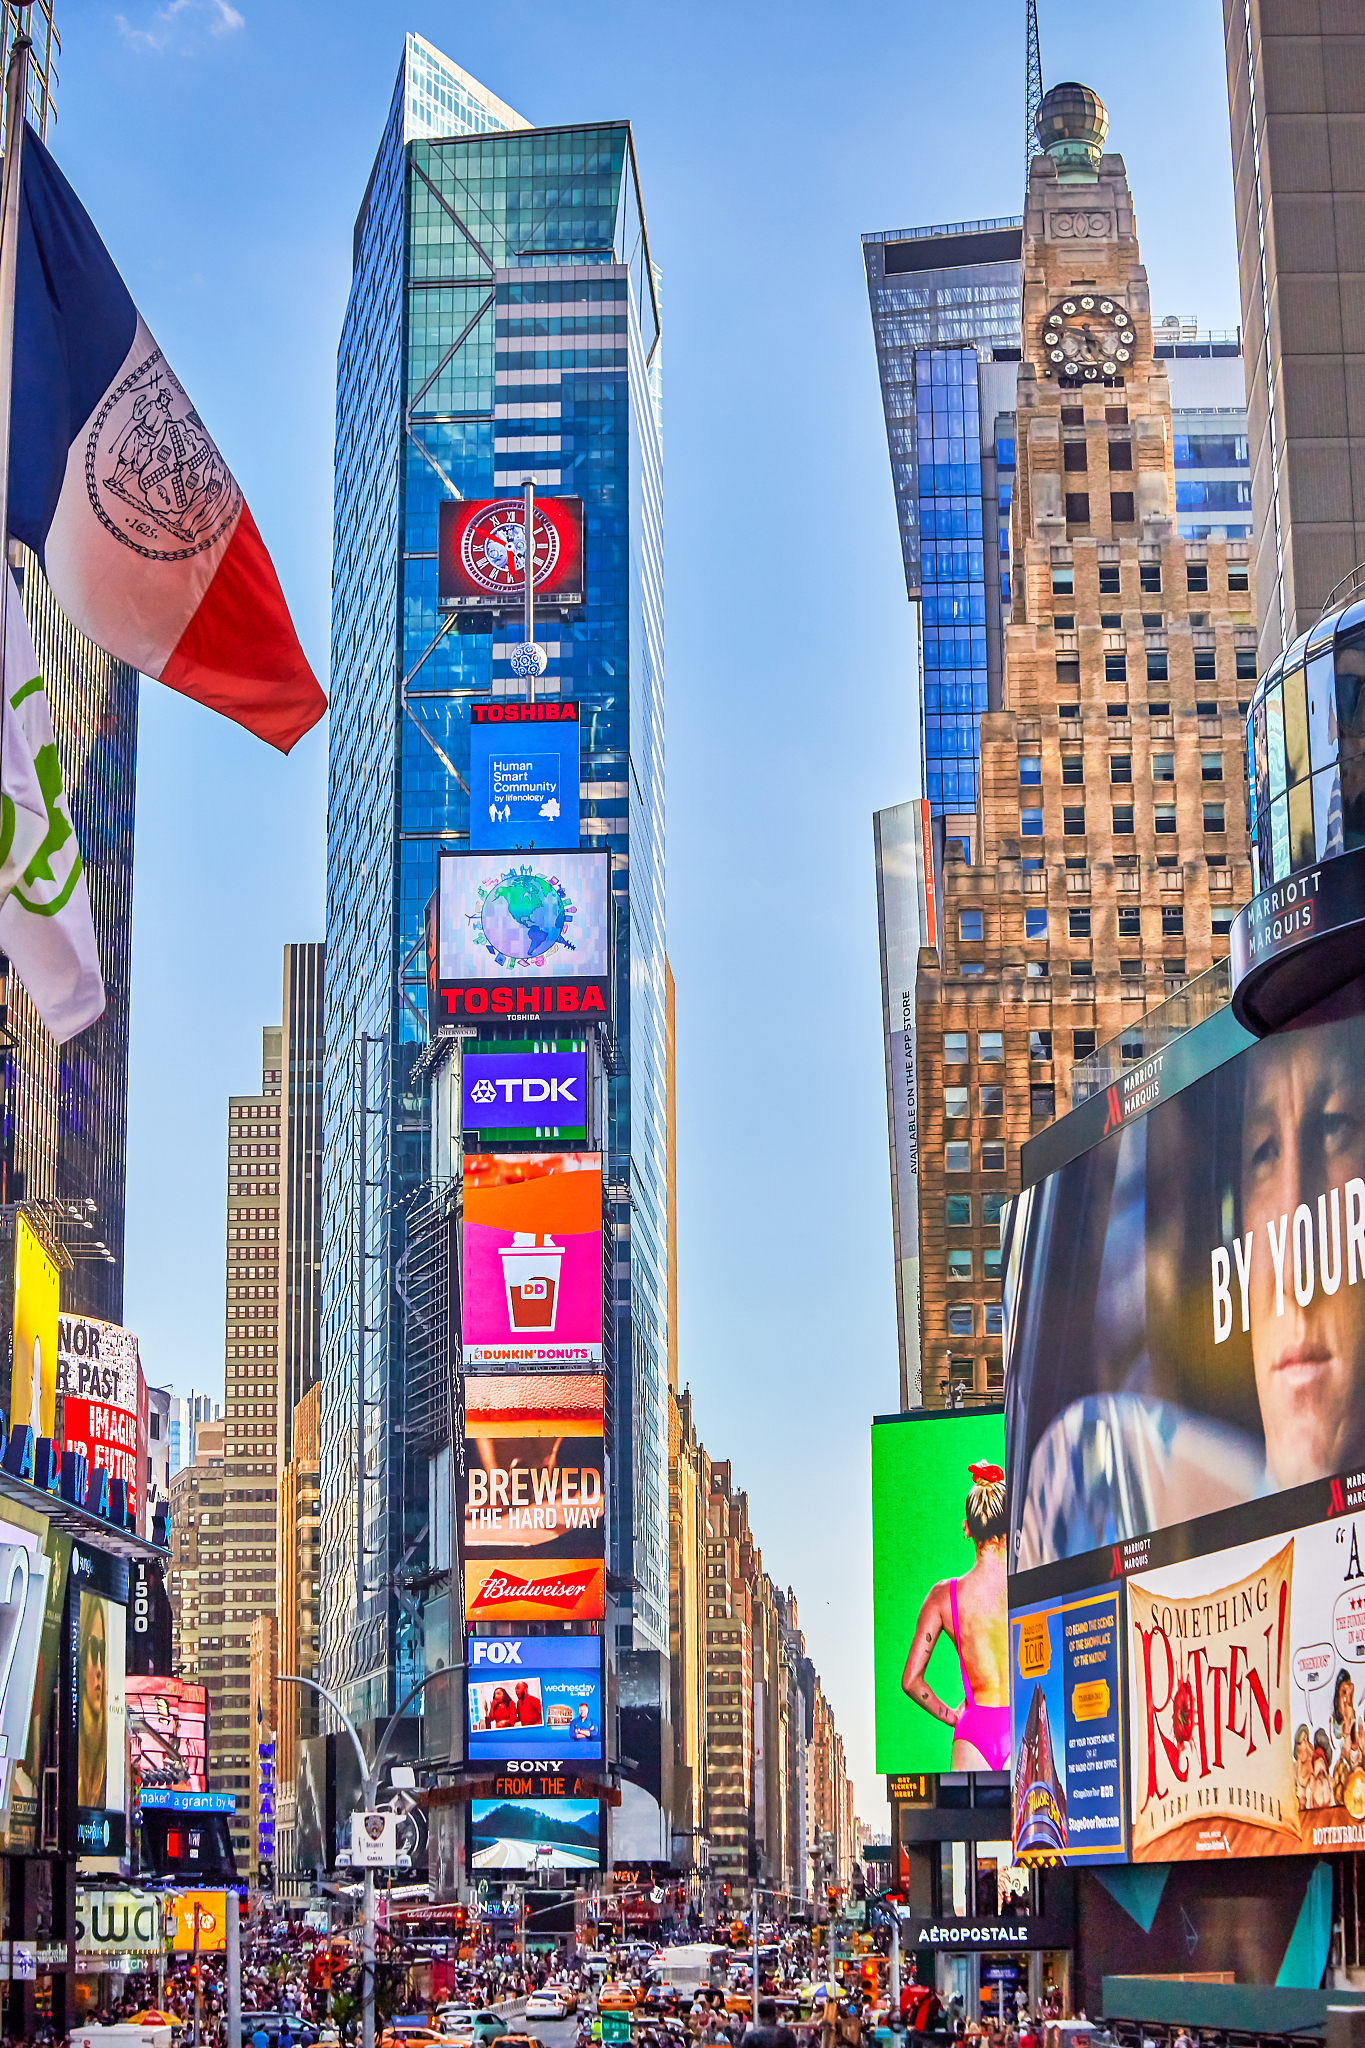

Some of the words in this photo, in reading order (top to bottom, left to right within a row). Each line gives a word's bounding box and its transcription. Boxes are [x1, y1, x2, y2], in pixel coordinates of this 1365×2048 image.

[472, 704, 577, 722] TOSHIBA
[493, 761, 533, 772] Human
[493, 772, 528, 782] Smart
[493, 782, 557, 794] Community
[494, 794, 504, 803] by
[505, 793, 545, 803] lifenology
[1248, 871, 1321, 929] MARRIOTT
[1249, 906, 1312, 958] MARQUIS
[441, 986, 606, 1014] TOSHIBA
[902, 990, 911, 1031] STORE
[904, 1033, 913, 1059] APP
[906, 1061, 914, 1086] THE
[1124, 1056, 1164, 1093] MARRIOTT
[496, 1078, 578, 1103] TDK
[907, 1088, 915, 1107] ON
[1124, 1082, 1160, 1115] MARQUIS
[908, 1109, 918, 1175] AVAILABLE
[1211, 1231, 1254, 1346] BY
[1266, 1178, 1365, 1318] YOUR
[524, 1284, 545, 1295] DD
[538, 1349, 588, 1359] DONUTS
[79, 1363, 120, 1402] PAST
[469, 1468, 601, 1506] BREWED
[469, 1508, 502, 1530] THE
[508, 1508, 557, 1530] HARD
[563, 1507, 601, 1529] WAY
[1124, 1538, 1151, 1557] MARRIOTT
[1124, 1554, 1149, 1571] MARQUIS
[134, 1564, 149, 1633] 1500
[479, 1578, 586, 1599] Budweiser
[1151, 1578, 1269, 1639] SOMETHING
[473, 1642, 523, 1665] FOX
[1025, 1642, 1045, 1665] TOUR
[544, 1683, 596, 1694] wednesday
[1076, 1738, 1087, 1748] YOUR
[1087, 1736, 1101, 1746] TICKETS
[1101, 1733, 1116, 1744] ONLINE
[507, 1761, 564, 1772] SONY
[1068, 1764, 1076, 1774] THE
[1087, 1762, 1096, 1772] CITY
[1096, 1761, 1104, 1771] BOX
[1104, 1759, 1118, 1770] OFFICE
[497, 1778, 532, 1795] FROM
[540, 1778, 565, 1795] THE
[182, 1796, 213, 1810] grant
[216, 1796, 226, 1810] by
[1163, 1793, 1189, 1822] VERY
[1198, 1787, 1220, 1808] NEW
[1229, 1787, 1283, 1822] MUSICAL
[1069, 1815, 1120, 1833] StageDoorTour.com
[919, 1925, 1028, 1942] AÉROPOSTALE
